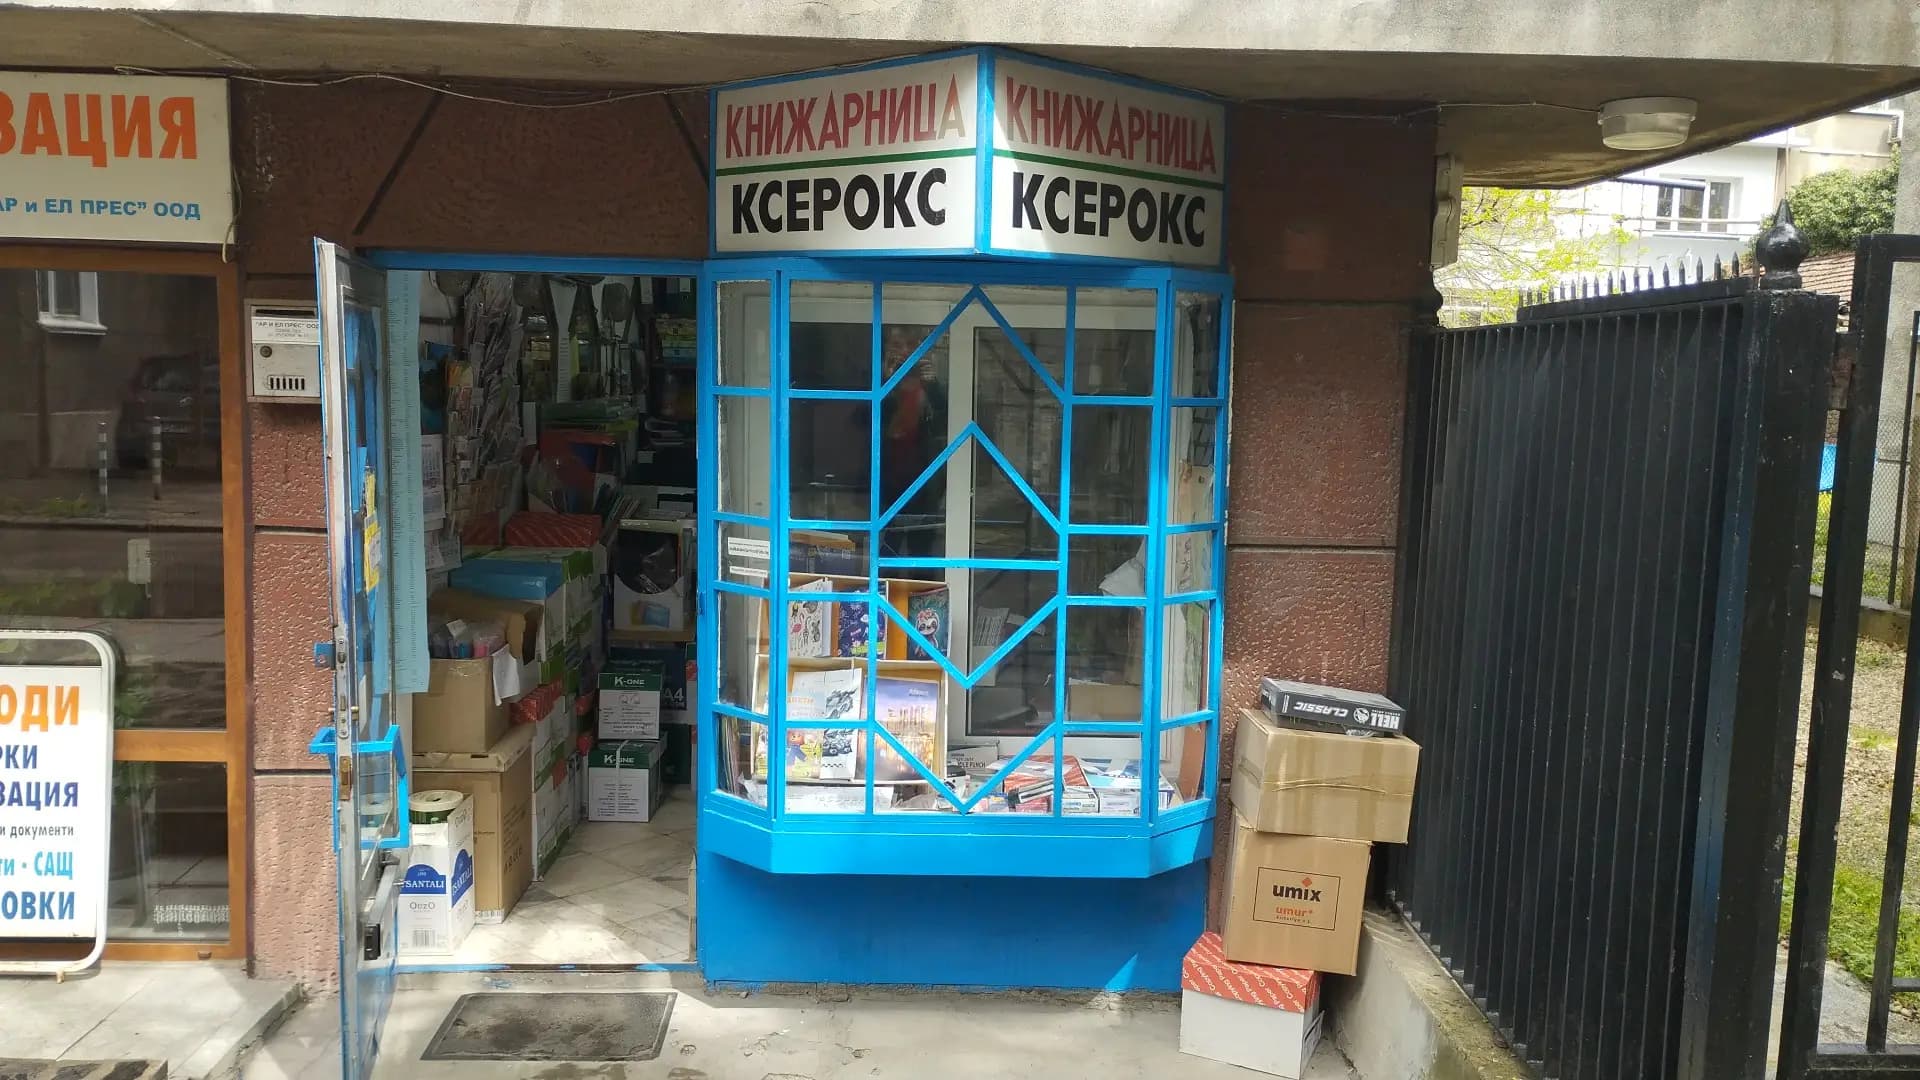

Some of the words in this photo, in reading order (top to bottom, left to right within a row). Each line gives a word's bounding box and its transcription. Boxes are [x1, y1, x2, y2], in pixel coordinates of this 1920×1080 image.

[726, 73, 966, 159] КНИЖАРНИЦА
[1006, 76, 1217, 175] КНИЖАРНИЦА
[25, 201, 38, 213] и
[45, 198, 73, 214] ЕЛ
[153, 202, 201, 220] ООД
[732, 167, 947, 234] КСЕРОКС
[1012, 171, 1206, 248] КСЕРОКС
[614, 676, 645, 686] K-ONE
[1293, 701, 1349, 718] CLASSIC
[1370, 711, 1400, 729] HELL
[0, 744, 38, 769] КИ
[10, 826, 74, 840] документи
[34, 850, 73, 880] САЩ
[1272, 877, 1322, 902] umix
[1, 891, 75, 920] ОВКИ
